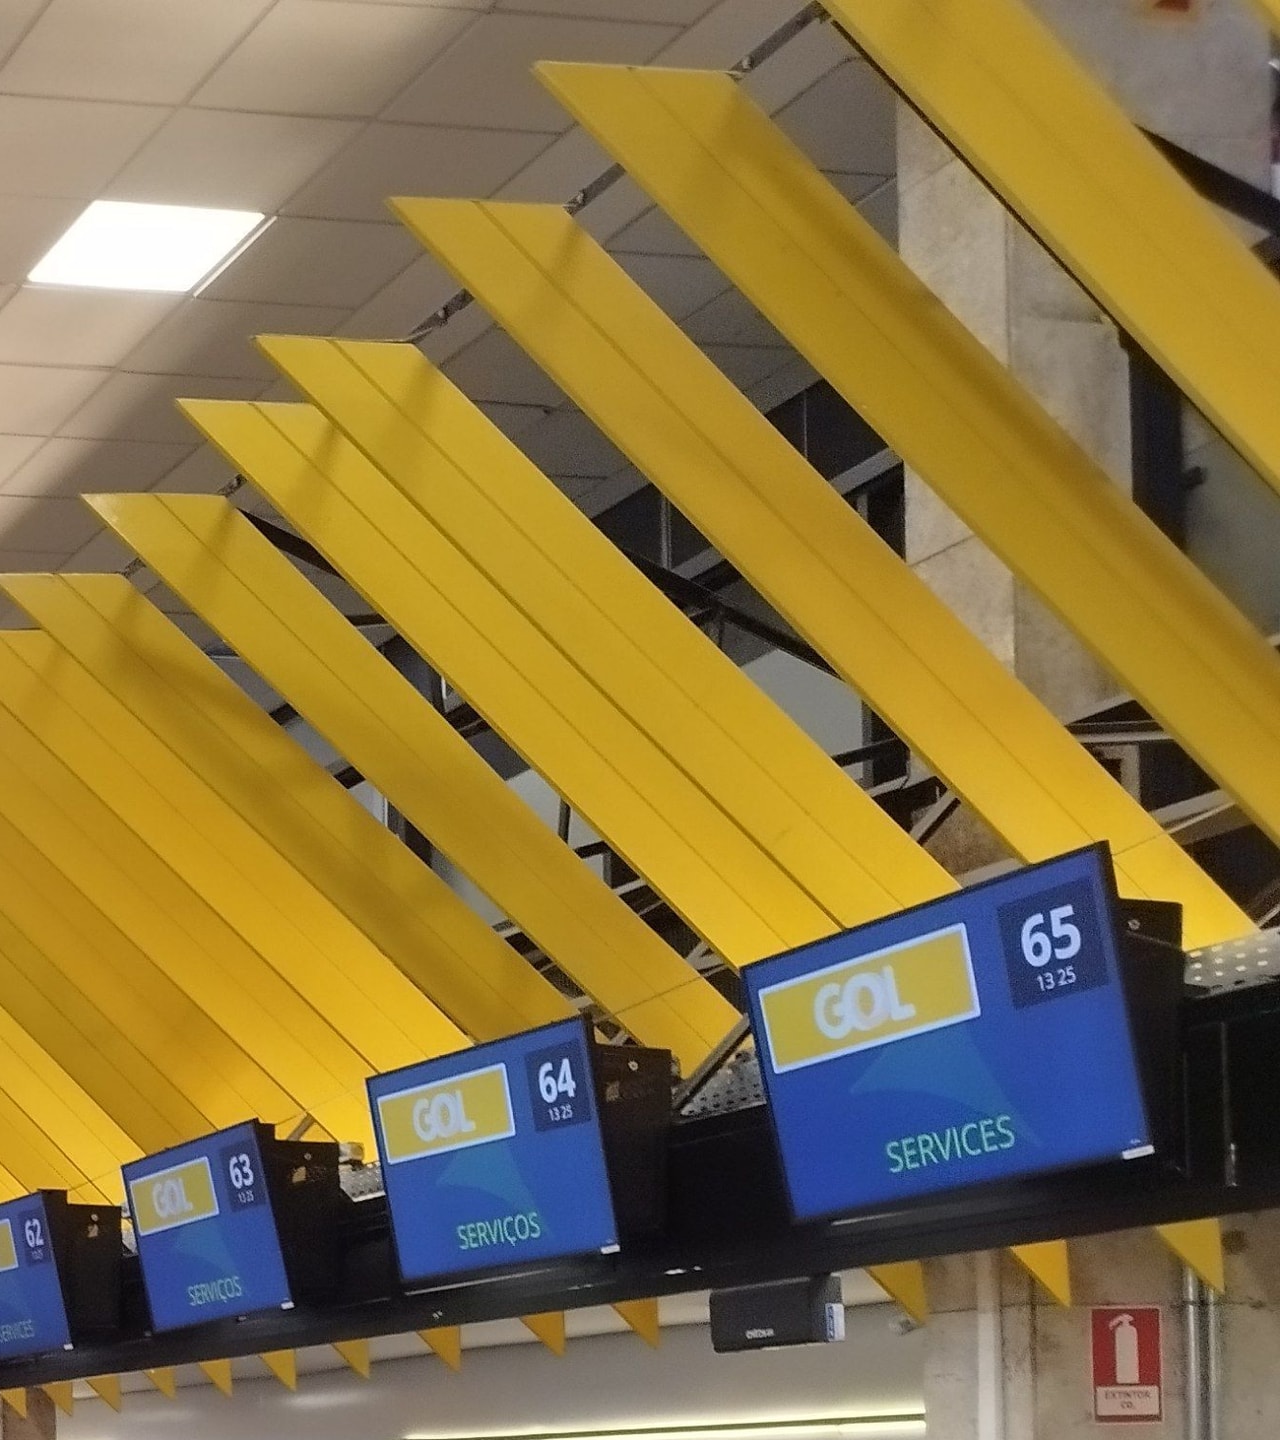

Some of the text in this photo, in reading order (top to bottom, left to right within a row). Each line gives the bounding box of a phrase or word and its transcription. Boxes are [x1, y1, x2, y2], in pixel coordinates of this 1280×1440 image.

[1021, 904, 1082, 967] 65
[814, 964, 917, 1040] GOL
[539, 1058, 576, 1103] 64
[413, 1089, 477, 1142] GOL
[885, 1115, 1016, 1173] SERVICES
[229, 1153, 254, 1189] 63
[25, 1218, 45, 1248] 62
[456, 1212, 541, 1250] SERVIÇOS
[1104, 1389, 1152, 1400] EXTINTOR
